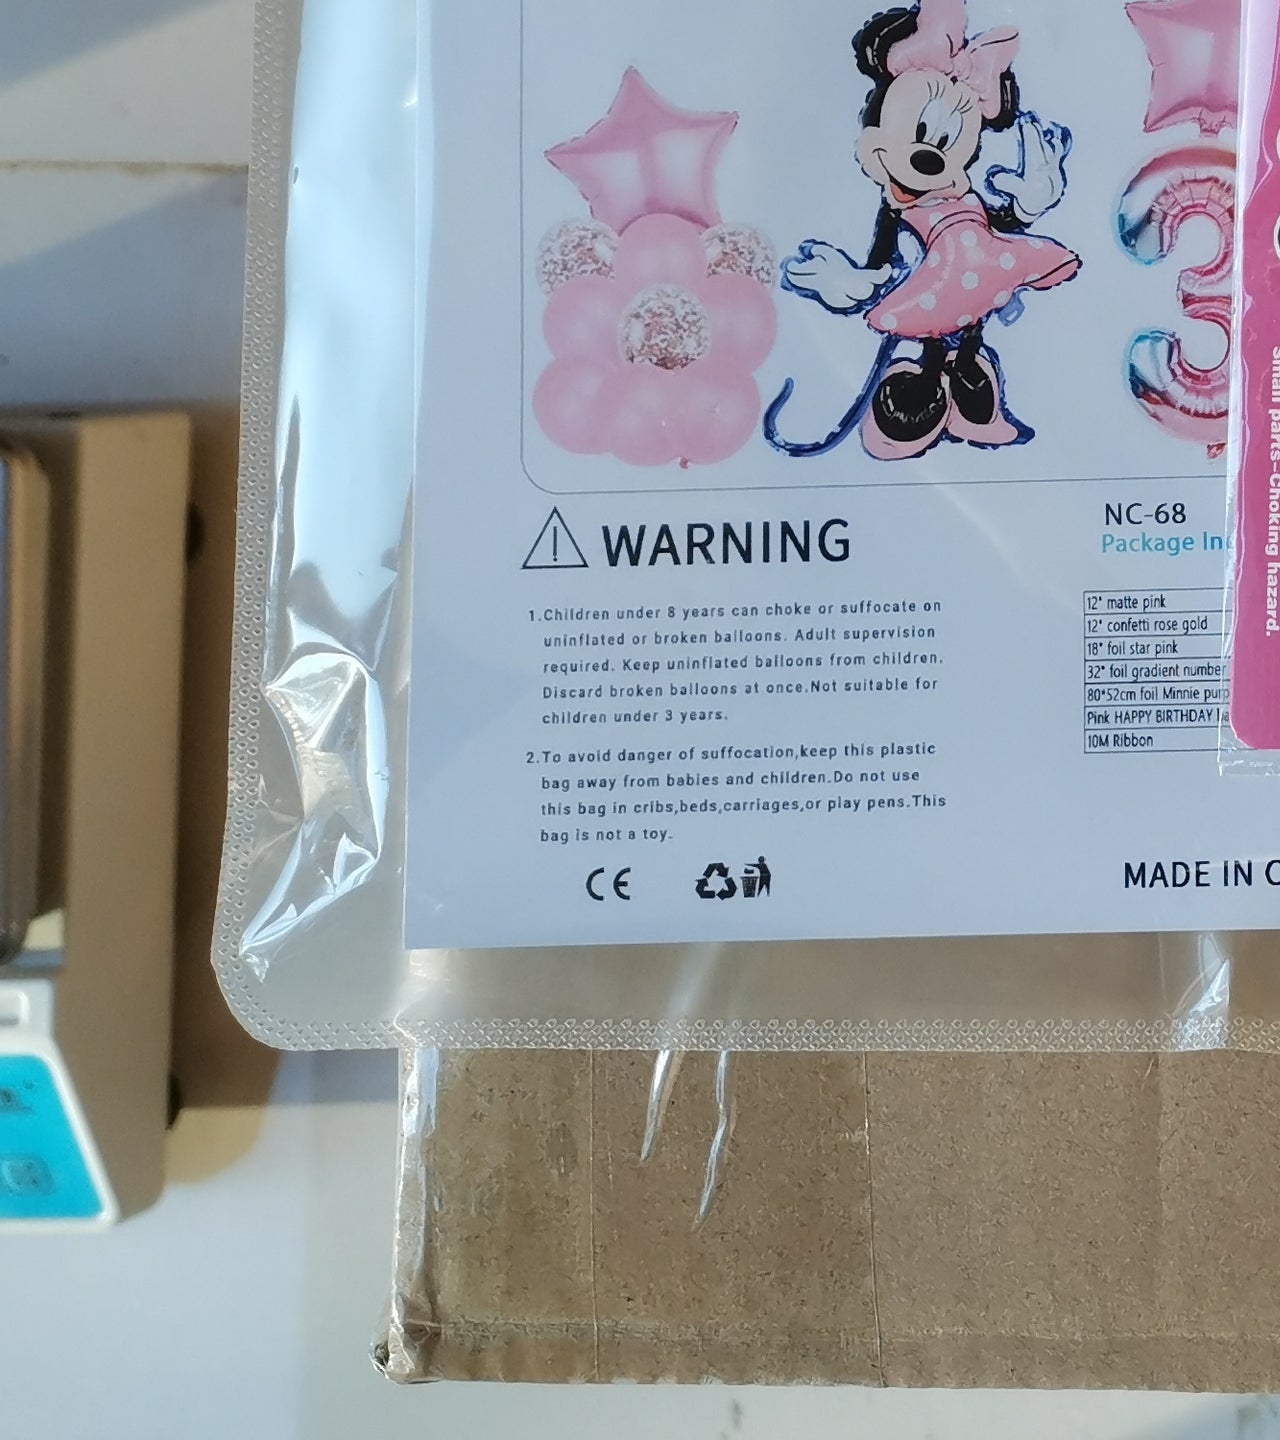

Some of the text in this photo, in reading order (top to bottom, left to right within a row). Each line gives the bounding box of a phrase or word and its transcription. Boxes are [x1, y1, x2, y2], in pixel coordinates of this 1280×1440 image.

[1105, 503, 1187, 526] NC-68
[602, 518, 850, 567] WARNING
[1102, 533, 1195, 556] Package
[1107, 596, 1138, 609] matte
[1143, 594, 1166, 612] pink
[1265, 561, 1280, 637] hazard.
[617, 606, 661, 619] under
[668, 606, 675, 618] 8
[683, 607, 724, 620] years
[732, 605, 758, 617] can
[766, 602, 811, 616] choke
[818, 604, 834, 614] or
[840, 600, 916, 614] suffocate
[923, 602, 941, 612] on
[1107, 617, 1149, 632] confetti
[1154, 620, 1178, 631] rose
[1183, 616, 1208, 634] gold
[544, 625, 935, 647] uninflated or broken balloons. Adult supervision
[1107, 641, 1125, 655] foil
[1130, 642, 1150, 654] star
[1155, 640, 1178, 658] pink
[543, 651, 943, 676] required. Keep uninflated balloons from children.
[1110, 664, 1127, 678] foil
[1132, 663, 1179, 681] gradient
[1184, 662, 1226, 676] number
[543, 685, 602, 699] Discard
[610, 684, 663, 697] broken
[670, 682, 737, 696] balloons
[745, 682, 759, 694] at
[844, 678, 908, 691] suitable
[916, 677, 938, 690] for
[1141, 686, 1158, 700] foil
[1163, 686, 1199, 700] Minnie
[542, 710, 728, 724] children under 3 years.
[1087, 711, 1109, 725] Pink
[1115, 710, 1151, 724] HAPPY
[1156, 709, 1213, 723] BIRTHDAY
[1088, 733, 1153, 748] 10M Ribbon
[568, 749, 611, 763] avoid
[618, 749, 672, 763] danger
[678, 747, 695, 760] of
[844, 743, 874, 756] this
[881, 742, 936, 758] plastic
[542, 776, 570, 792] bag
[577, 778, 616, 791] away
[623, 775, 660, 787] from
[666, 773, 719, 786] babies
[726, 772, 754, 785] and
[860, 771, 885, 782] not
[892, 771, 919, 781] use
[541, 803, 571, 815] this
[578, 802, 606, 817] bag
[613, 802, 626, 814] in
[828, 795, 860, 812] play
[541, 828, 673, 844] bag is not a toy.
[1123, 861, 1210, 889] MADE
[1223, 860, 1253, 886] IN
